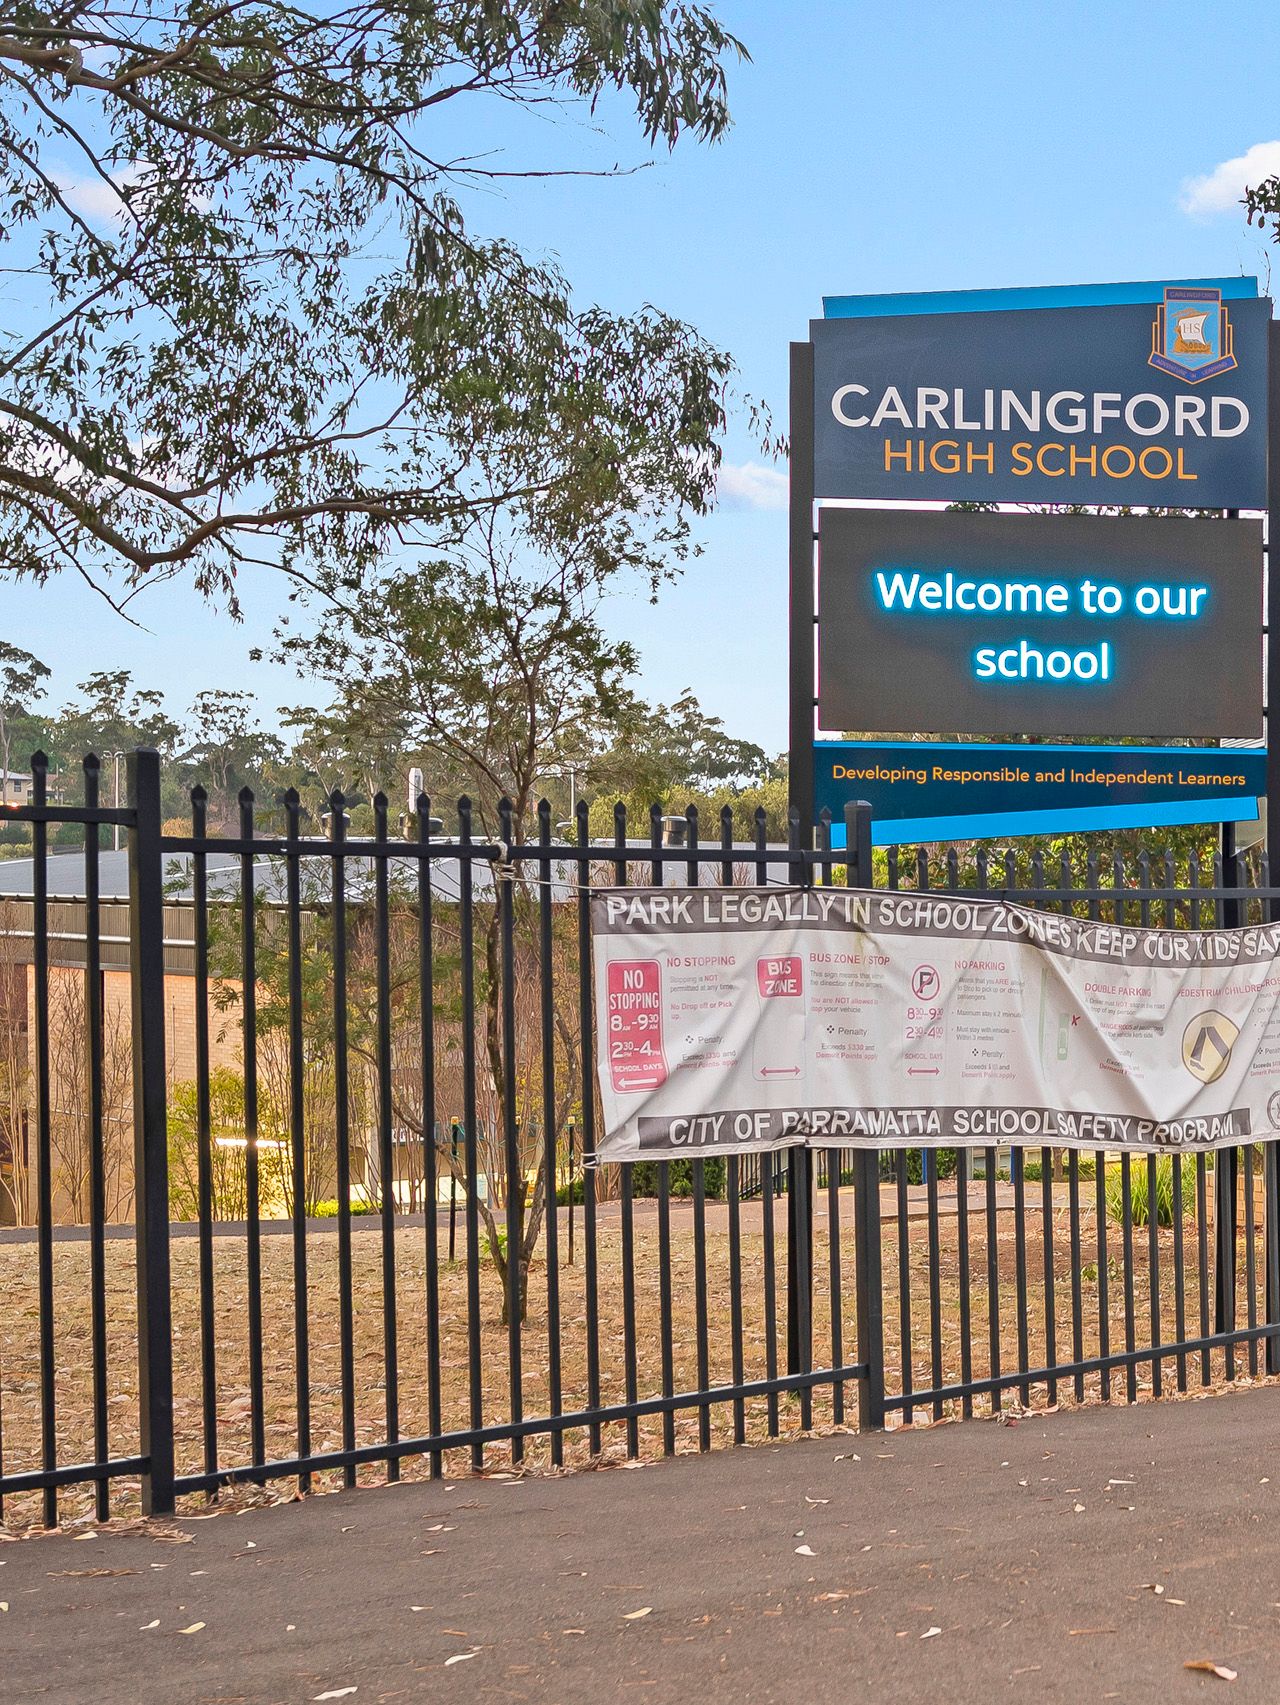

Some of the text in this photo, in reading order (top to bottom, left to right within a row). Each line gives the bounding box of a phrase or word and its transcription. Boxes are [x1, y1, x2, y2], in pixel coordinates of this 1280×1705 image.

[830, 383, 1251, 439] CARLINGFORD
[884, 438, 1199, 480] HIGH SCHOOL
[876, 572, 1207, 617] Welcome to our
[975, 641, 1110, 680] school
[832, 764, 1247, 788] Developing Responsible and Independent Learners
[607, 894, 694, 926] PARK
[702, 893, 837, 924] LEGALLY
[845, 896, 871, 925] IN
[878, 900, 988, 932] SCHOOL
[991, 907, 1072, 950] ZONES
[1074, 926, 1137, 959] KEEP
[1143, 934, 1192, 961] OUR
[1195, 935, 1240, 961] KIDS
[666, 955, 736, 968] NO STOPPING
[767, 960, 792, 977] BUS
[809, 952, 832, 963] BUS
[834, 953, 860, 965] ZONE
[868, 955, 890, 966] STOP
[954, 960, 1006, 972] NO PARKING
[623, 969, 644, 989] NO
[764, 978, 798, 995] ZONE
[1084, 982, 1152, 998] DOUBLE PARKING
[609, 992, 659, 1010] STOPPING
[614, 1062, 664, 1073] SCHOOL DAYS
[668, 1109, 1235, 1146] CITY OF PARRAMATTA SCHOOL SAFETY PROGRAM
